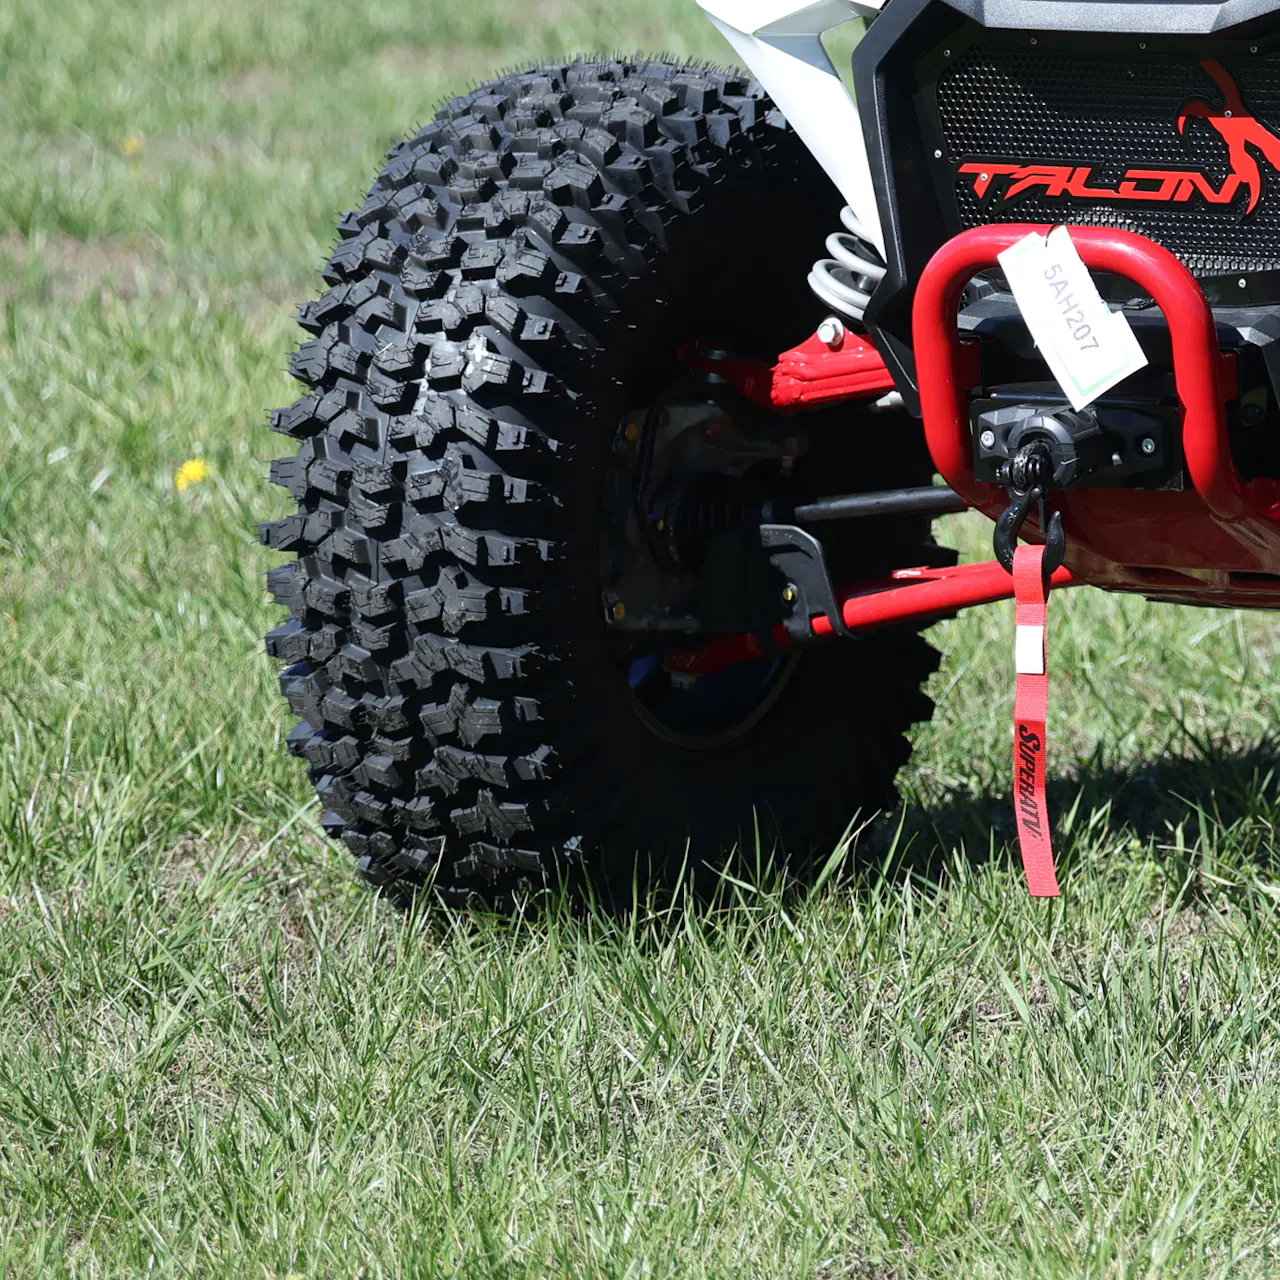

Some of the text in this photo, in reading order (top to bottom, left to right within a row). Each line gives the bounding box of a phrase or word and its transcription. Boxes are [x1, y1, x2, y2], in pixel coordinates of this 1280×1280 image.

[958, 163, 1246, 204] TALON
[1044, 263, 1100, 351] 5AH207
[1019, 724, 1041, 837] SUPERATV
